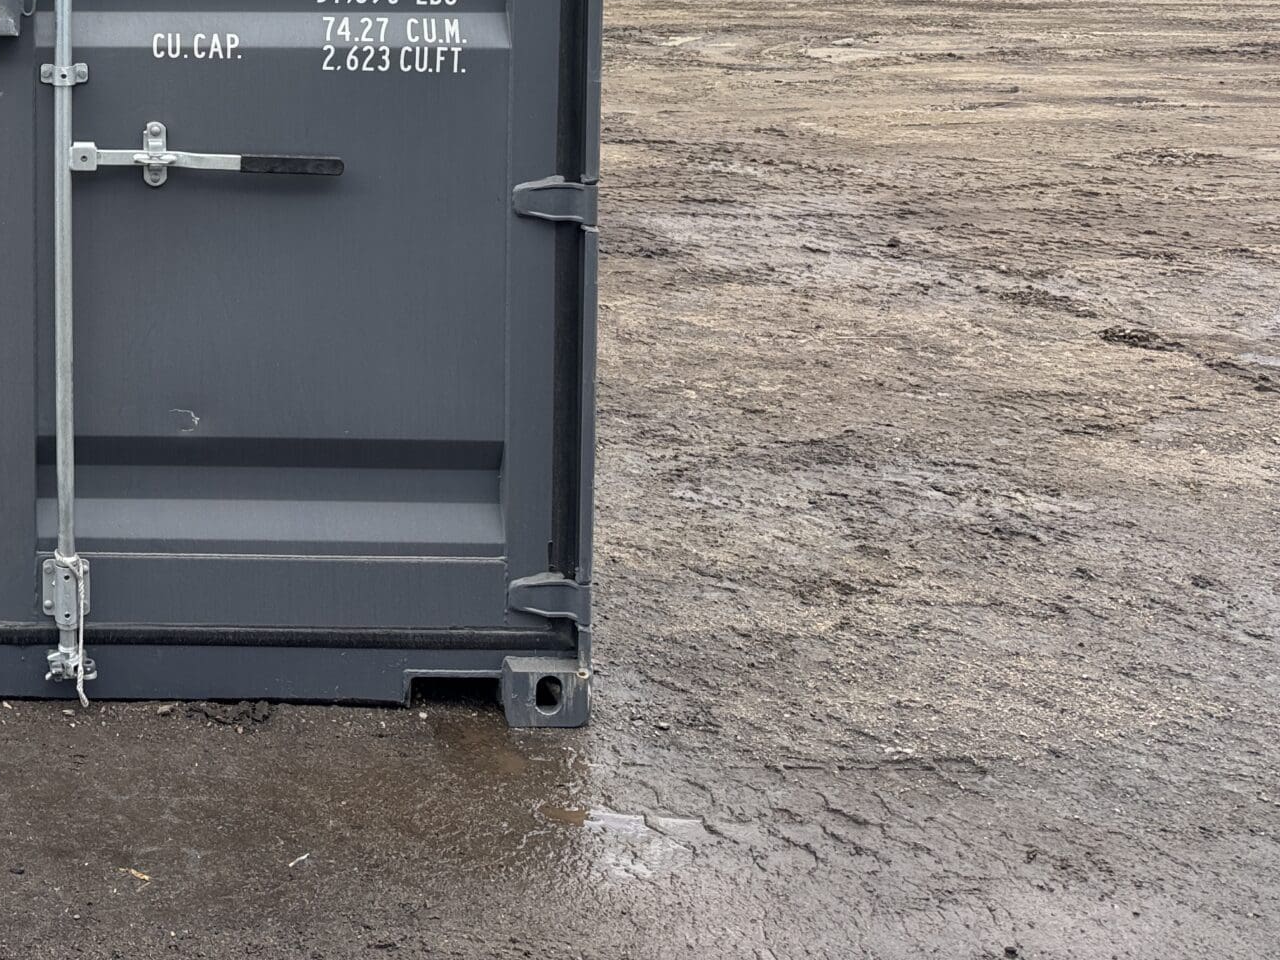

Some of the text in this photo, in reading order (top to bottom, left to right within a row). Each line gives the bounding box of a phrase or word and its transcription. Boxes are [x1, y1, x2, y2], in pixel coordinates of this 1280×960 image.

[322, 16, 468, 44] 74.27 CU.M.
[153, 33, 242, 59] CU.CAP.
[400, 46, 466, 73] CU.FT.
